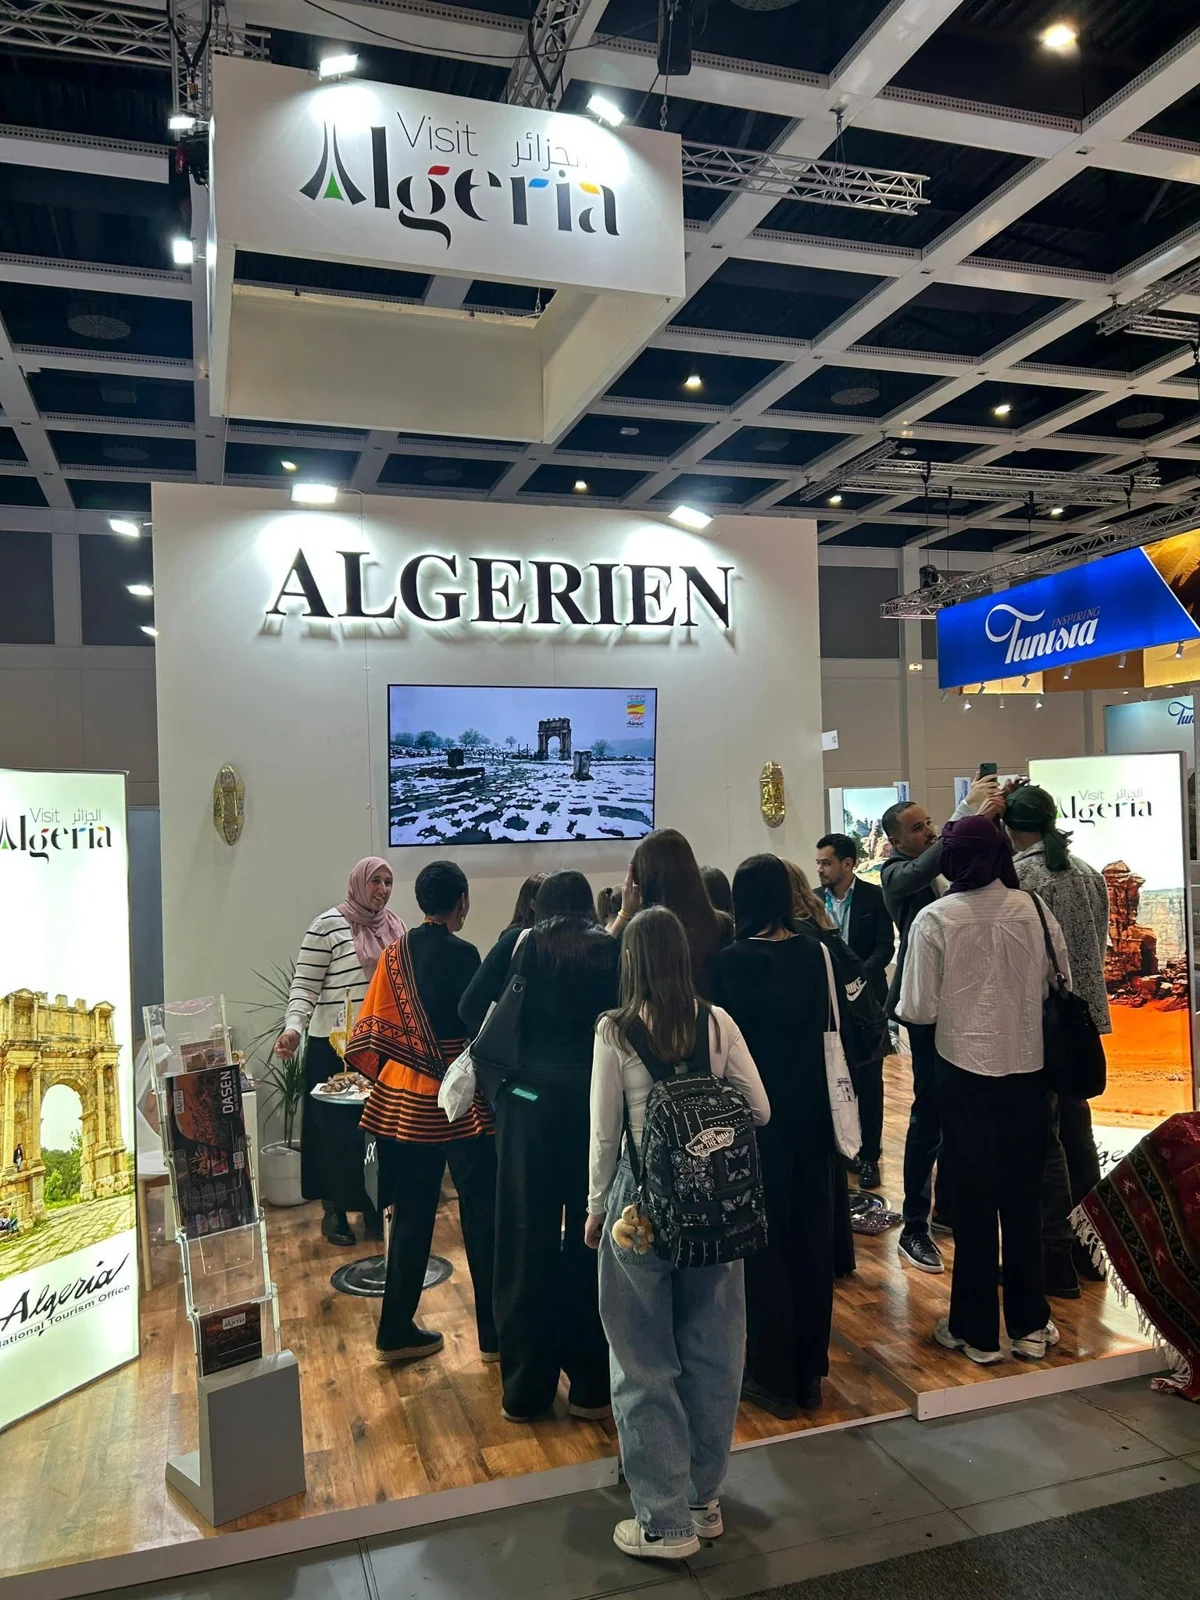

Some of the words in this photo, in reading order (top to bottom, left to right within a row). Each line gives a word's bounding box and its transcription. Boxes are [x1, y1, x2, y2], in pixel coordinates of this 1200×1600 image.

[396, 111, 478, 157] Visit
[299, 119, 620, 250] Algeria
[265, 547, 735, 629] ALGERIEN
[985, 603, 1099, 664] Tunisia
[1052, 606, 1101, 628] INSPIRING
[29, 807, 61, 823] Visit
[72, 808, 102, 825] الجزائر
[1078, 789, 1105, 801] Visit
[0, 814, 112, 864] Algeria
[845, 977, 863, 994] NIKE
[220, 1070, 234, 1114] OASEN
[0, 1252, 130, 1337] Algeria
[0, 1322, 45, 1348] ational
[48, 1300, 95, 1325] Tourism
[98, 1284, 130, 1302] Office
